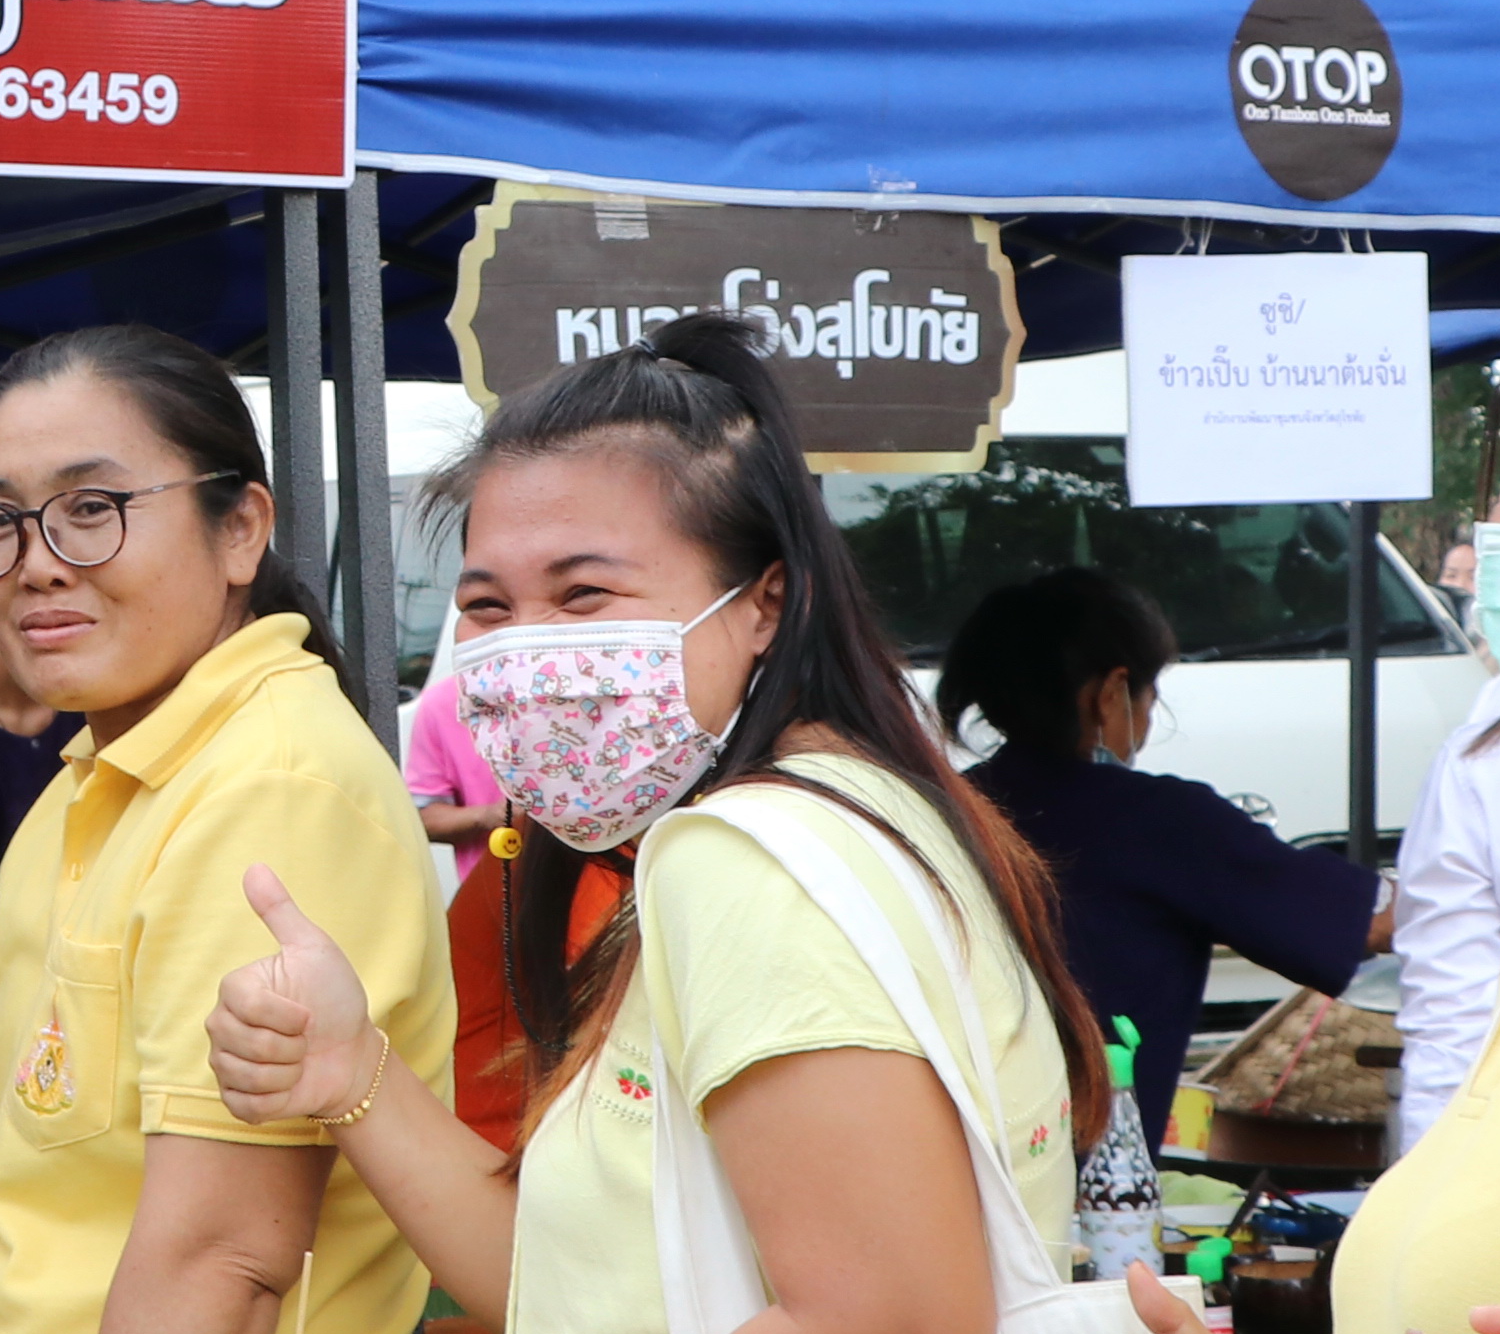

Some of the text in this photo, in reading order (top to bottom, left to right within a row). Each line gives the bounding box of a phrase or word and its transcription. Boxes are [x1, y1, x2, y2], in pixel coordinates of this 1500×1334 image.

[1238, 43, 1388, 105] OTOP
[1243, 103, 1391, 127] One Tambon One Product
